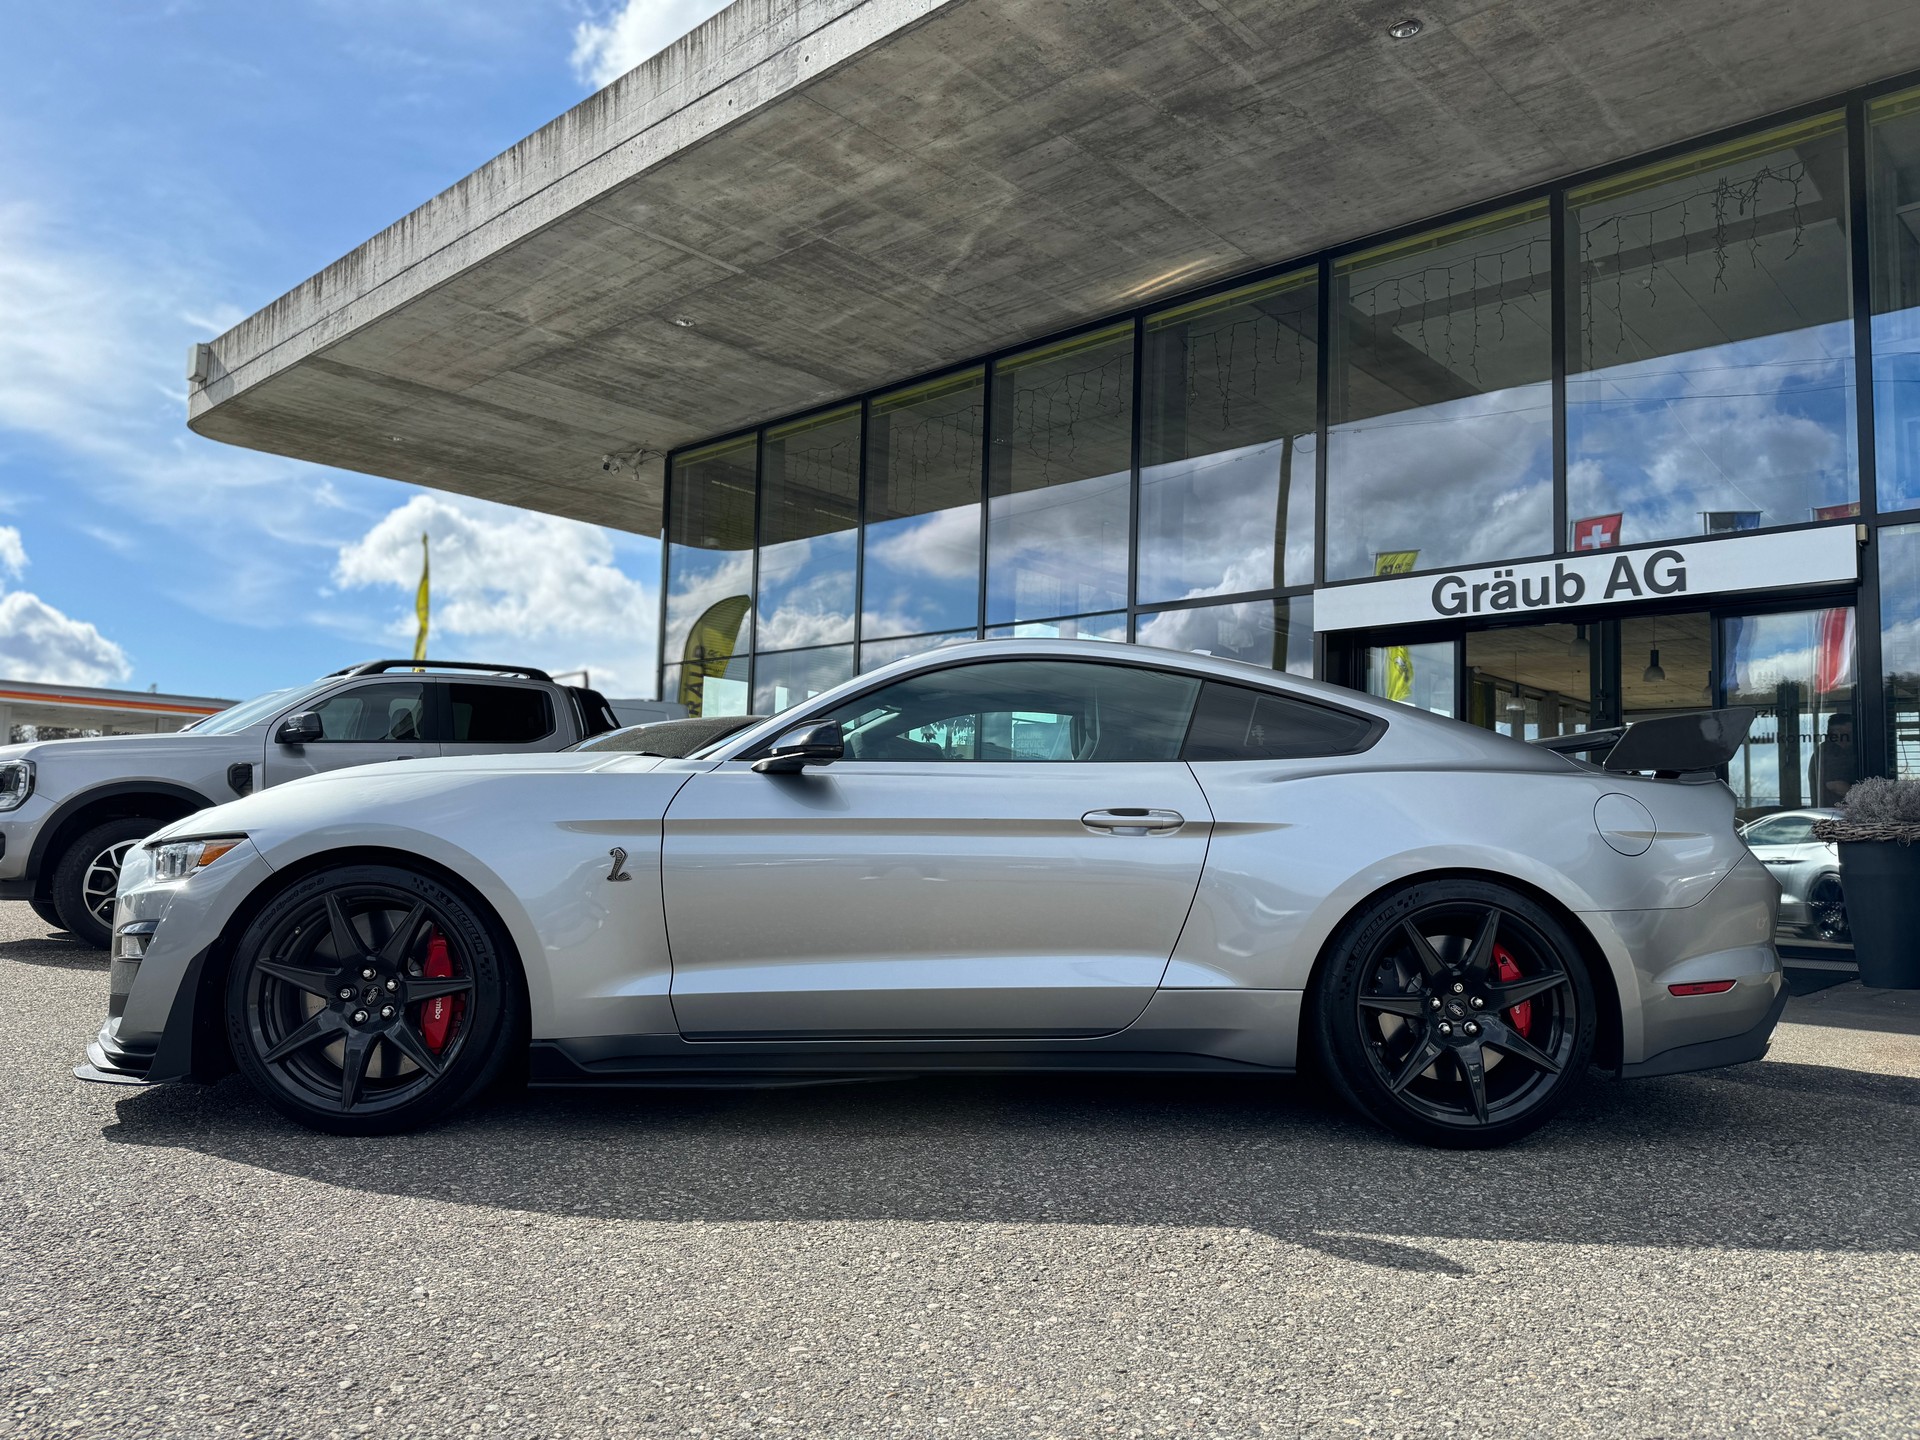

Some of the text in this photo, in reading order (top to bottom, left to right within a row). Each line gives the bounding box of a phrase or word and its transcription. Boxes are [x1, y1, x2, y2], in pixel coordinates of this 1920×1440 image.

[1432, 549, 1687, 616] Gräub AG
[1015, 740, 1046, 749] SERVICE
[1748, 732, 1850, 745] willkommen
[447, 901, 486, 955] MICHELIN
[1351, 906, 1397, 960] MICHELIN
